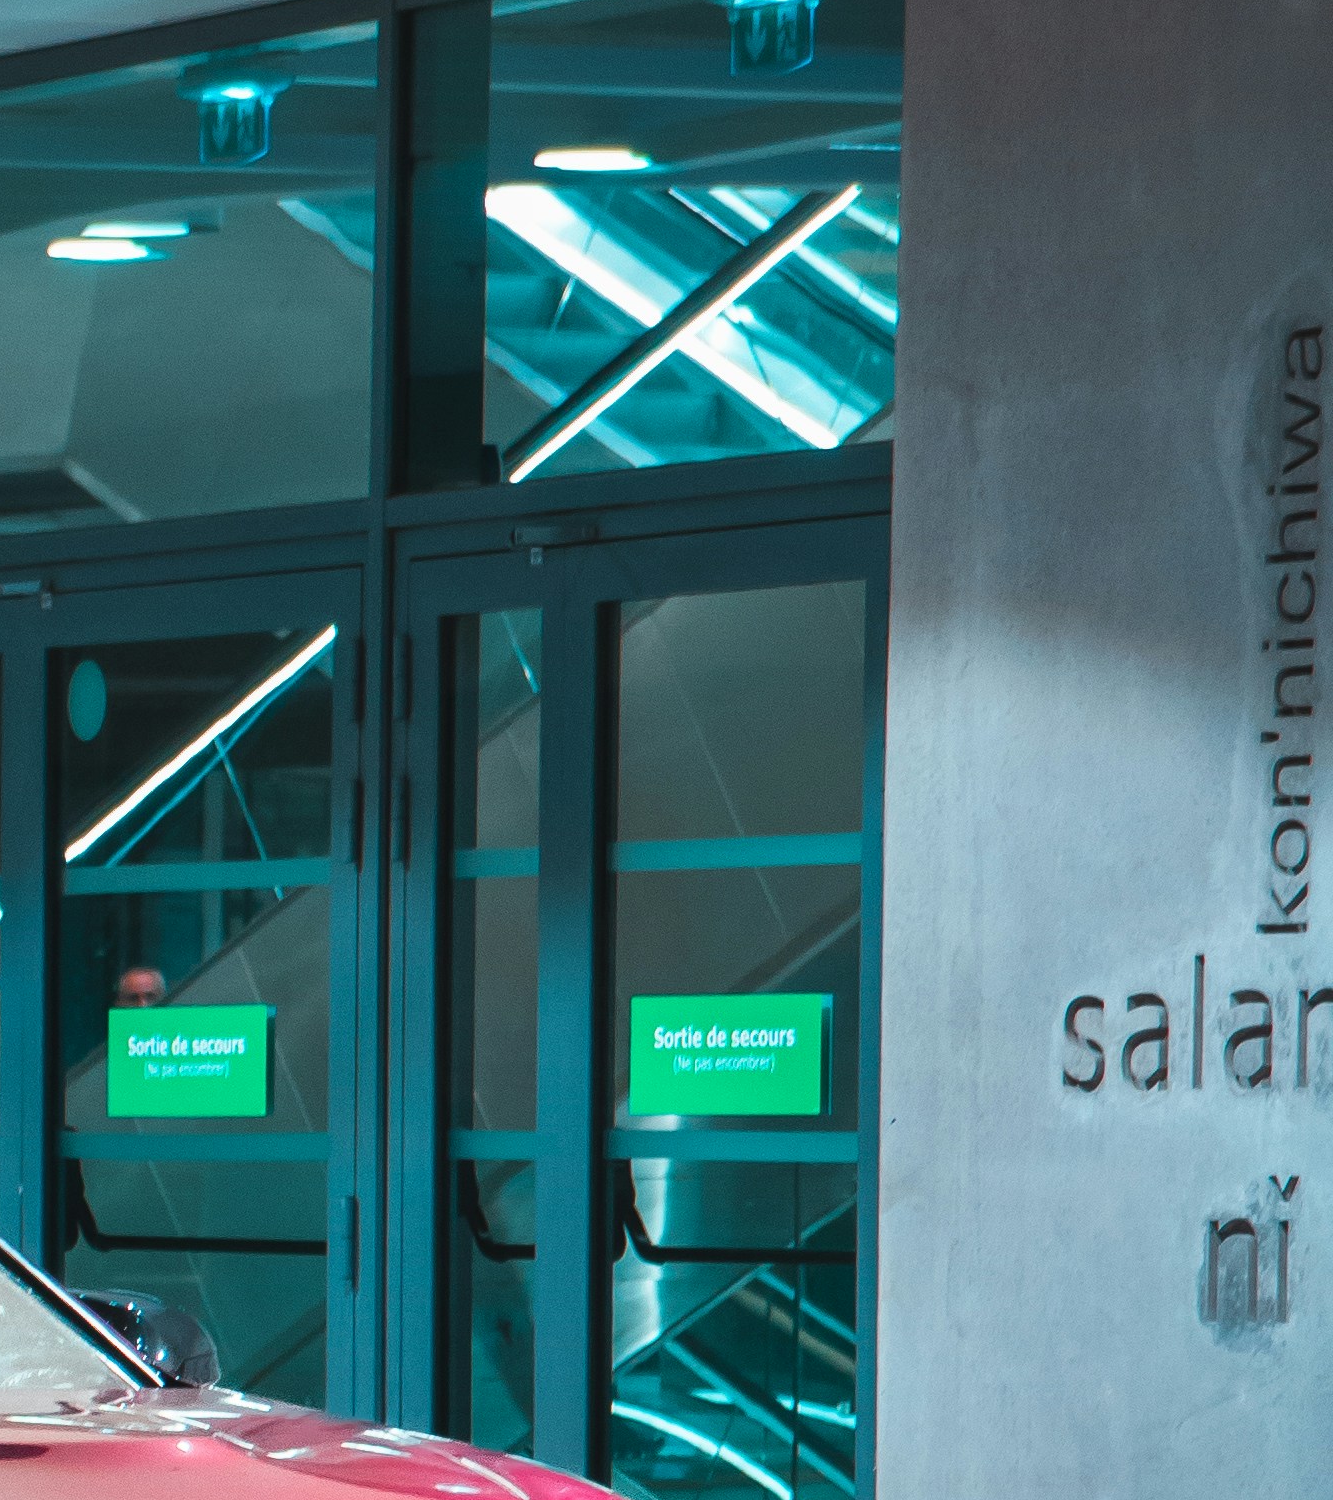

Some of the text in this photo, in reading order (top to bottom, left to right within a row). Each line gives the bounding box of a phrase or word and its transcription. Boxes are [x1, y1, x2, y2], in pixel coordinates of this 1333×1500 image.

[1256, 323, 1323, 935] kon'nichiwa
[127, 1033, 247, 1057] Sortie de secours
[653, 1023, 797, 1049] Sortie de secours
